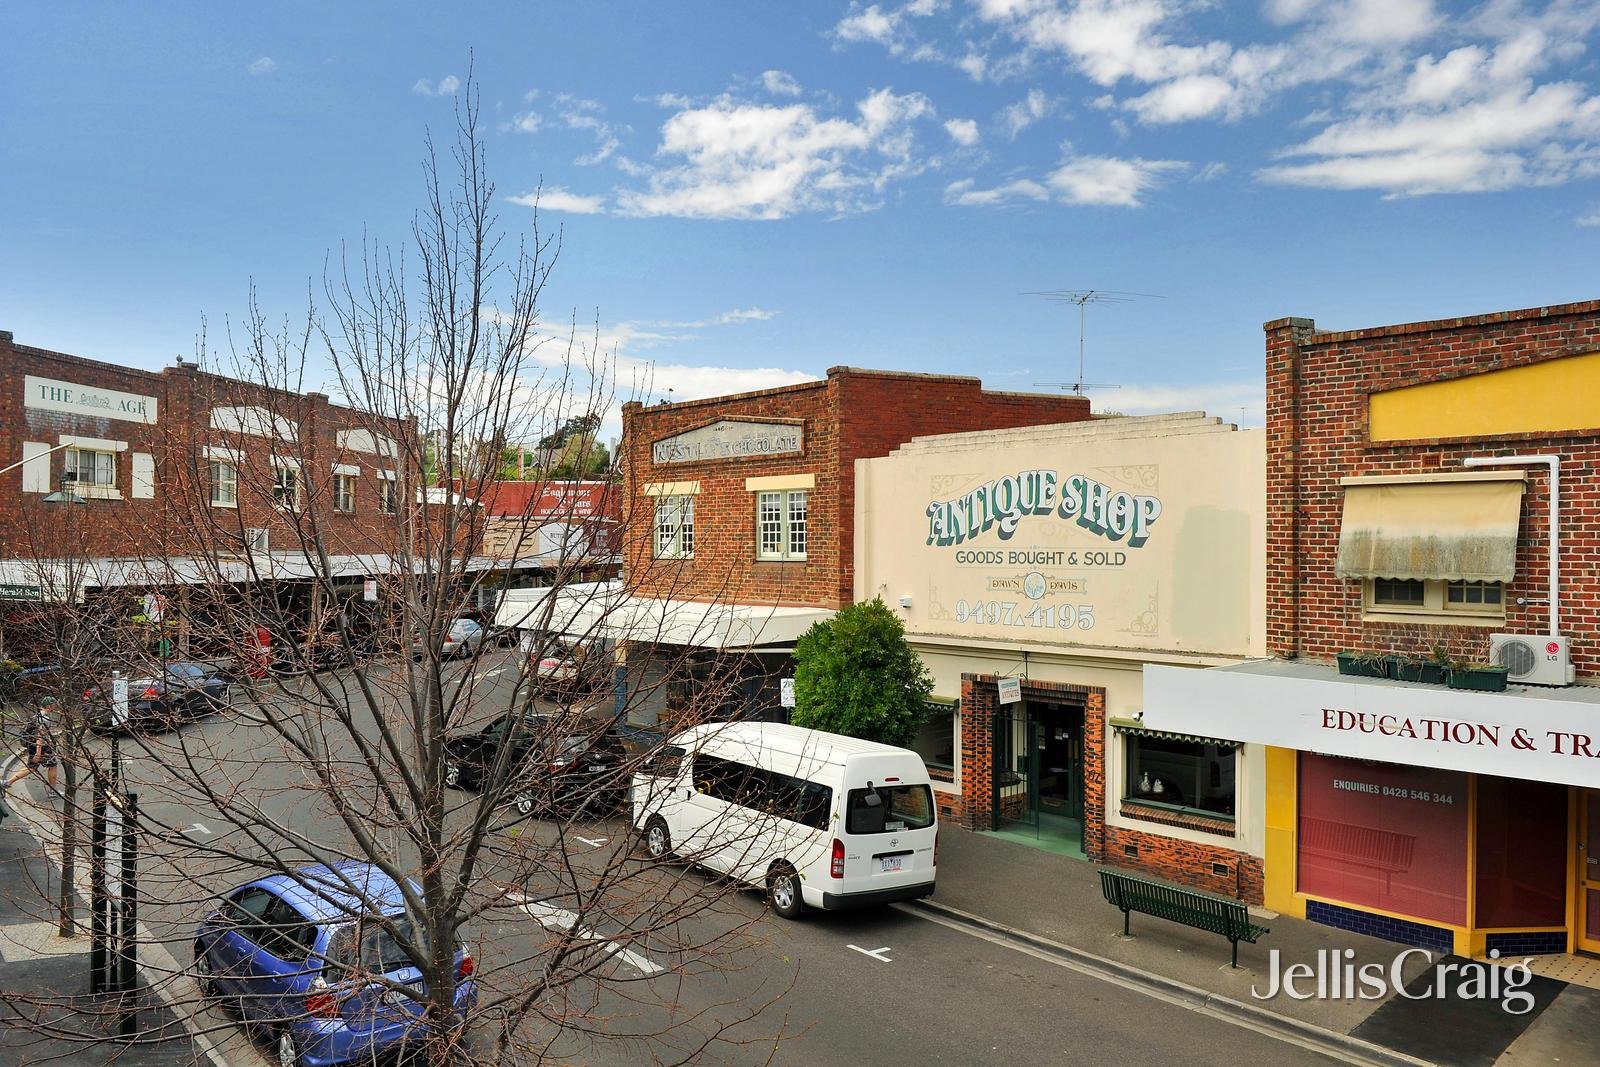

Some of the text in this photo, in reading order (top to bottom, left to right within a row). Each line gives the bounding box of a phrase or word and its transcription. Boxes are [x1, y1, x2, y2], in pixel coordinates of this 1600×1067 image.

[38, 384, 146, 415] THE AGE
[732, 434, 798, 455] CHOCOLATE
[926, 469, 1163, 548] ANTIQUE SHOP
[955, 550, 1127, 566] GOODS BOUGHT & SOLD
[1546, 654, 1559, 662] LG
[1321, 708, 1600, 758] EDUCATION & TR
[1333, 779, 1454, 805] ENQUIRIES 0428 546 344
